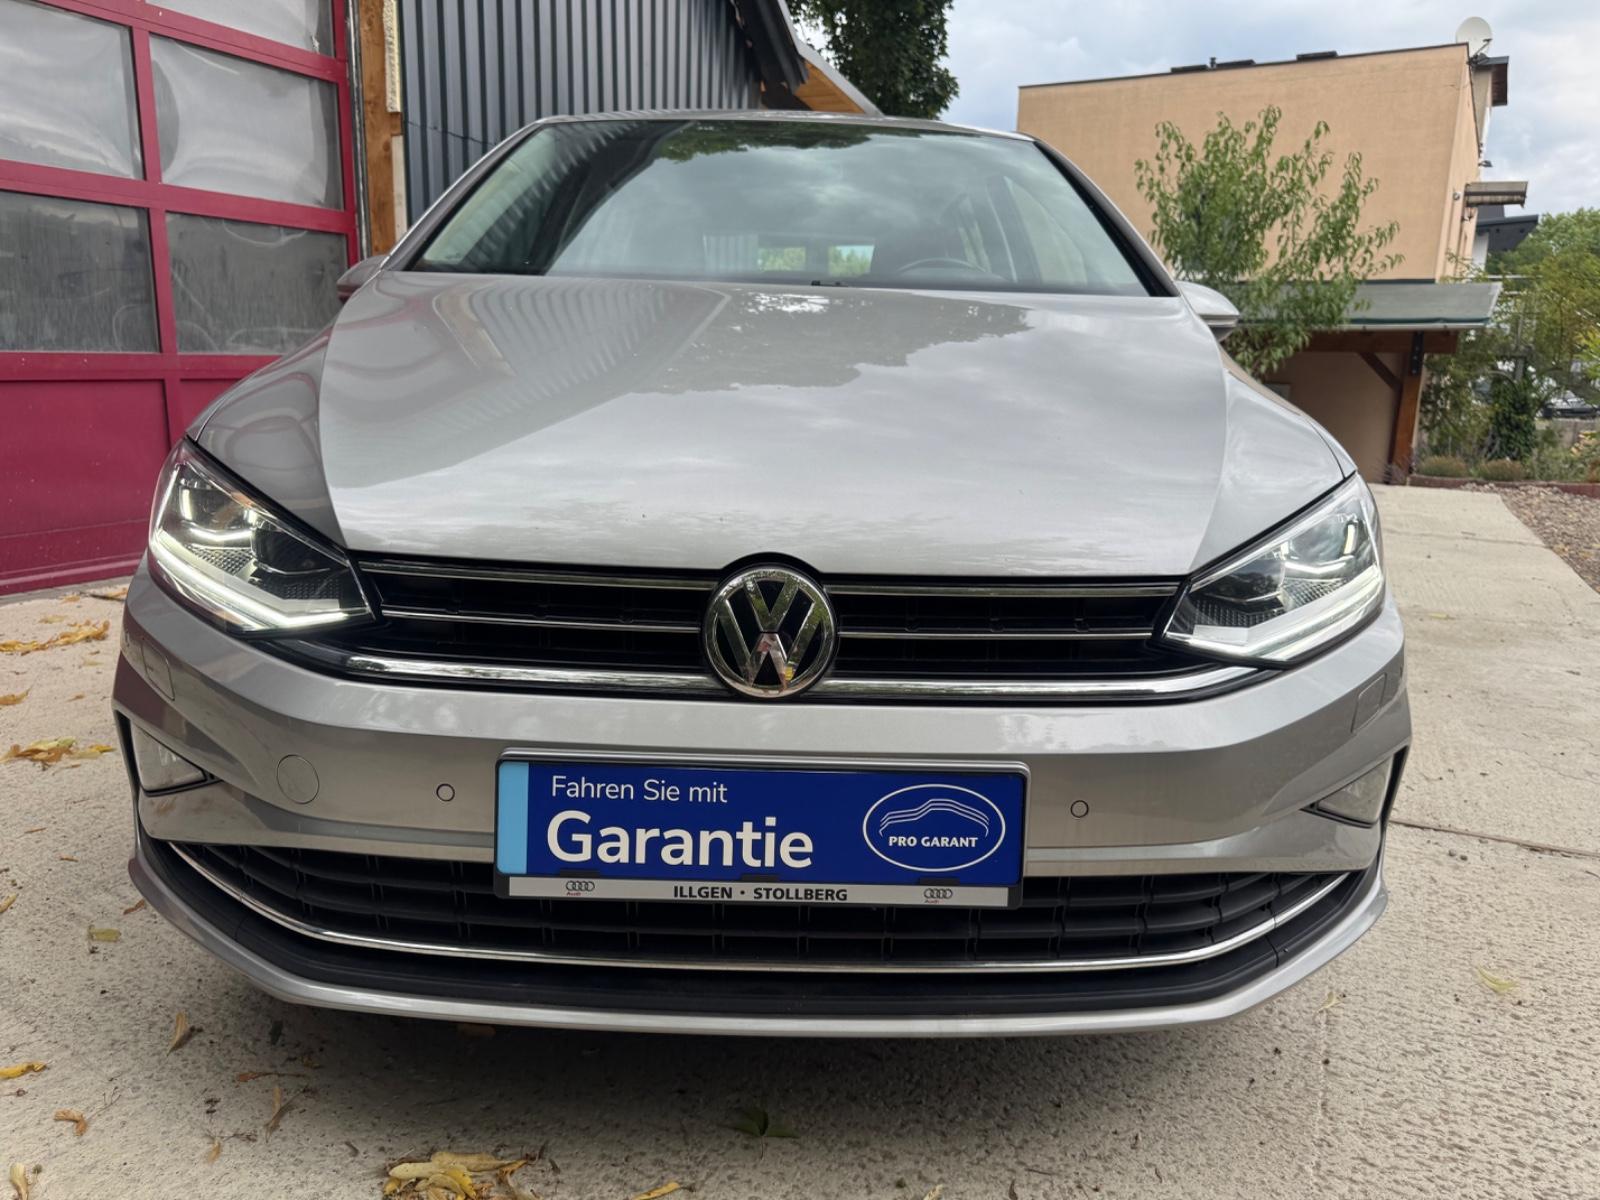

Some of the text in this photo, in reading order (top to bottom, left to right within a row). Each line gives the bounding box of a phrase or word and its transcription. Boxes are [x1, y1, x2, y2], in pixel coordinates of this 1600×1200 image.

[552, 775, 728, 803] Fahren Sie mit
[547, 809, 813, 868] Garantie
[889, 836, 978, 848] PRO GARANT
[673, 886, 848, 901] ILLGEN STOLLBERG
